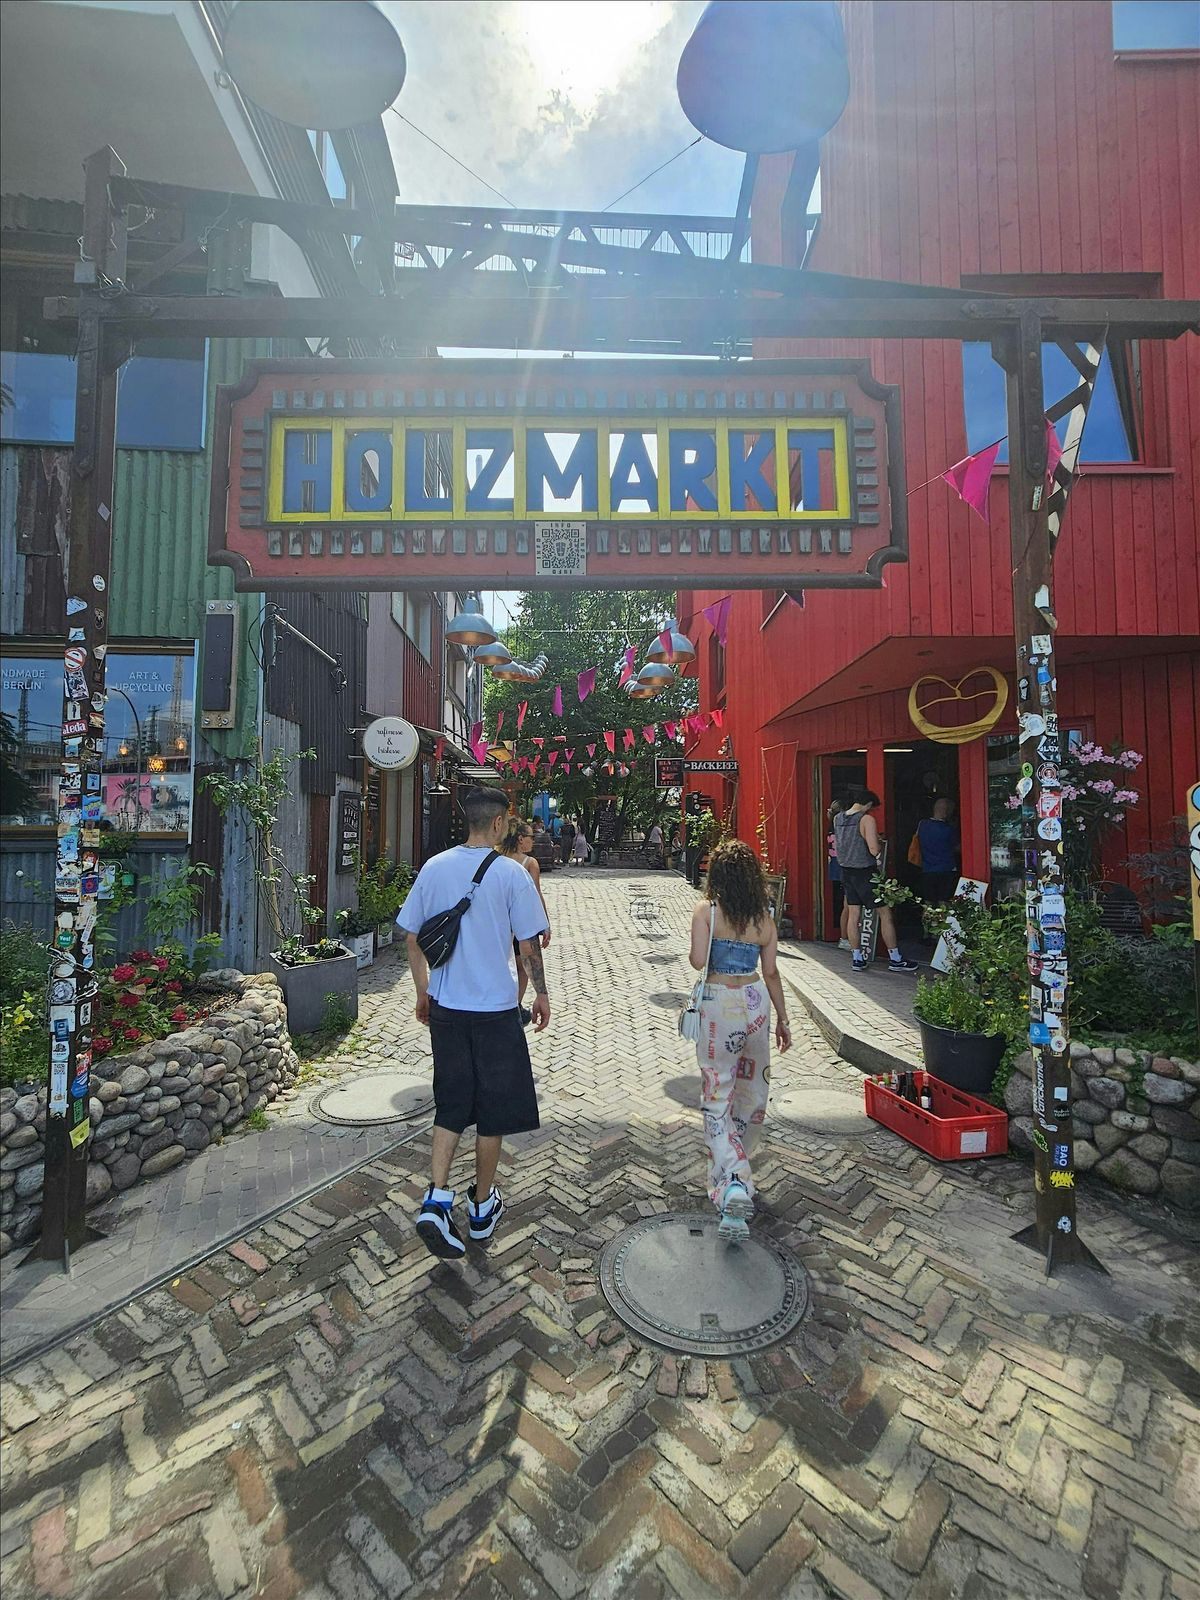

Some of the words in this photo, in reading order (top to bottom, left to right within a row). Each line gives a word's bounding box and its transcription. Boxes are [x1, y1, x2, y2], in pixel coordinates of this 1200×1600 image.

[283, 429, 836, 513] HOLZMARKT
[1, 668, 46, 678] NDMADE
[128, 671, 149, 680] ART
[151, 671, 160, 680] &
[3, 681, 42, 690] BERLIN
[115, 682, 172, 692] UPCYCLING
[386, 737, 393, 746] &
[1059, 1145, 1069, 1167] BAO
